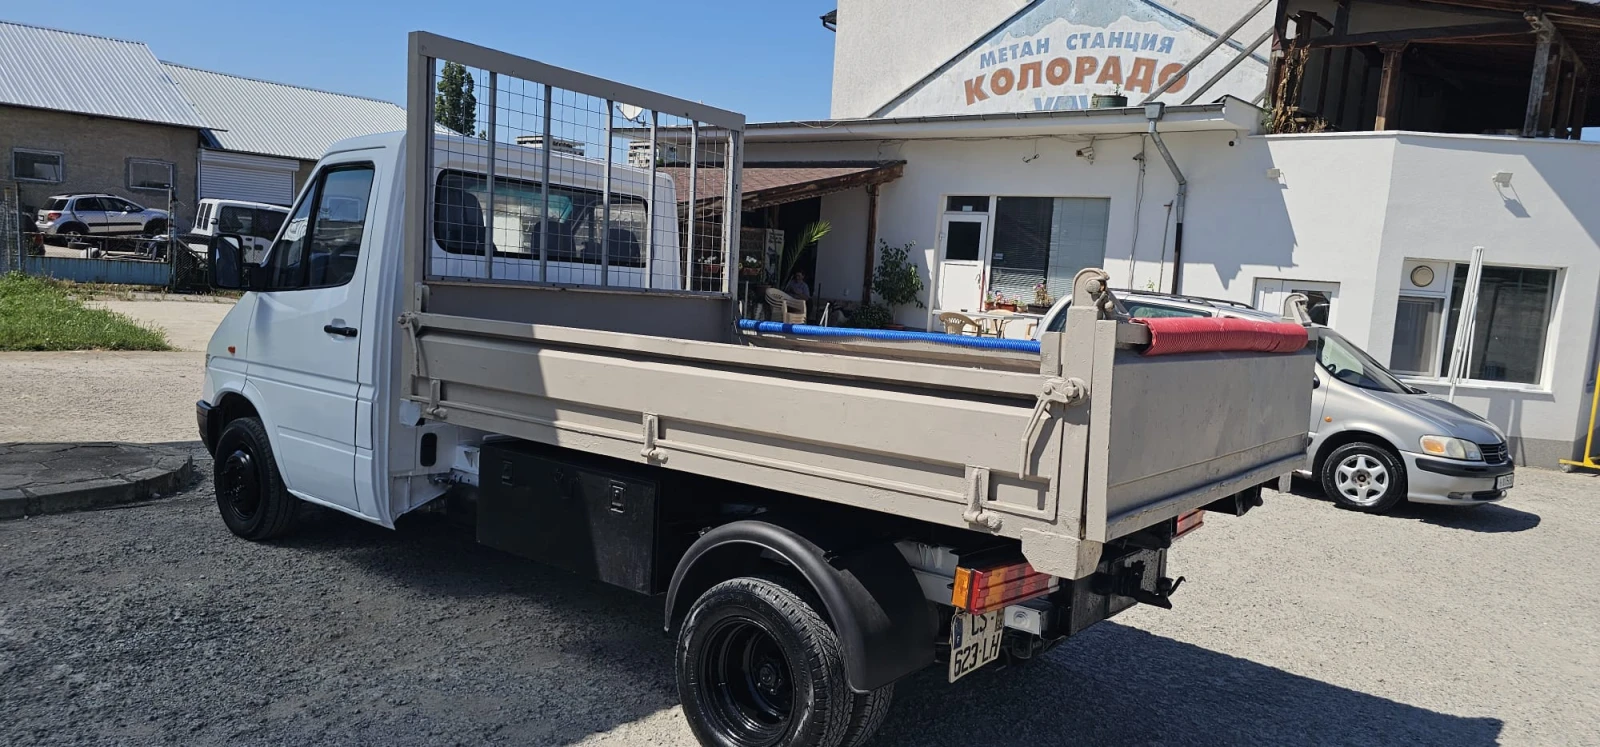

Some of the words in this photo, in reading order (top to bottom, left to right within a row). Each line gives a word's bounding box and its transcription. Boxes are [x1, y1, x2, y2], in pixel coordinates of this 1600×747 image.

[980, 37, 1050, 70] МЕТАН
[1066, 31, 1175, 54] СТАНЦИЯ
[964, 56, 1189, 105] КОЛОРАДО
